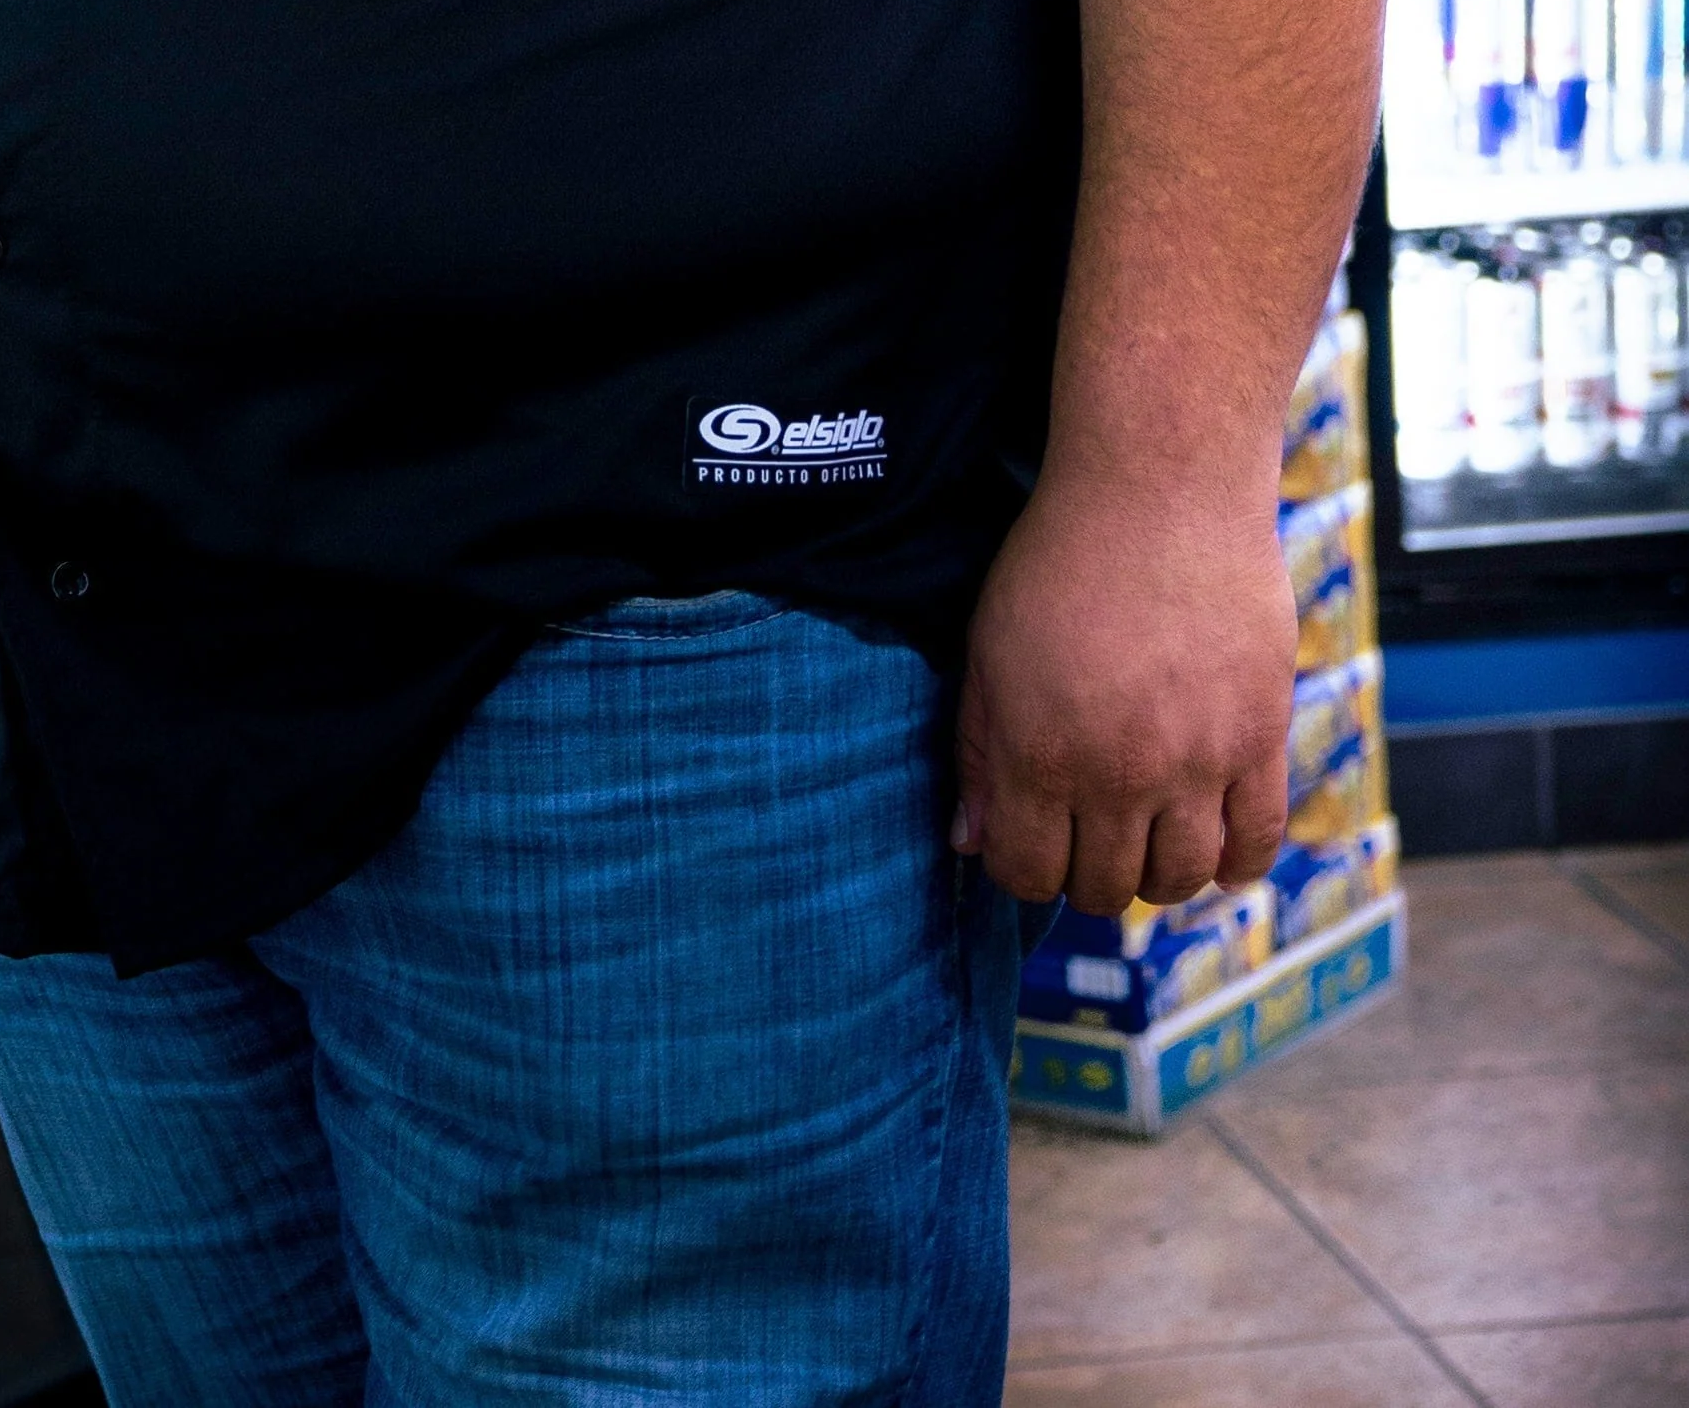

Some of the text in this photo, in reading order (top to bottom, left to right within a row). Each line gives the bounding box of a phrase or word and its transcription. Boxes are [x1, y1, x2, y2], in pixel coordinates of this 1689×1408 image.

[782, 408, 885, 451] elsiglo
[698, 461, 885, 485] PRODUCTO OFICIAL
